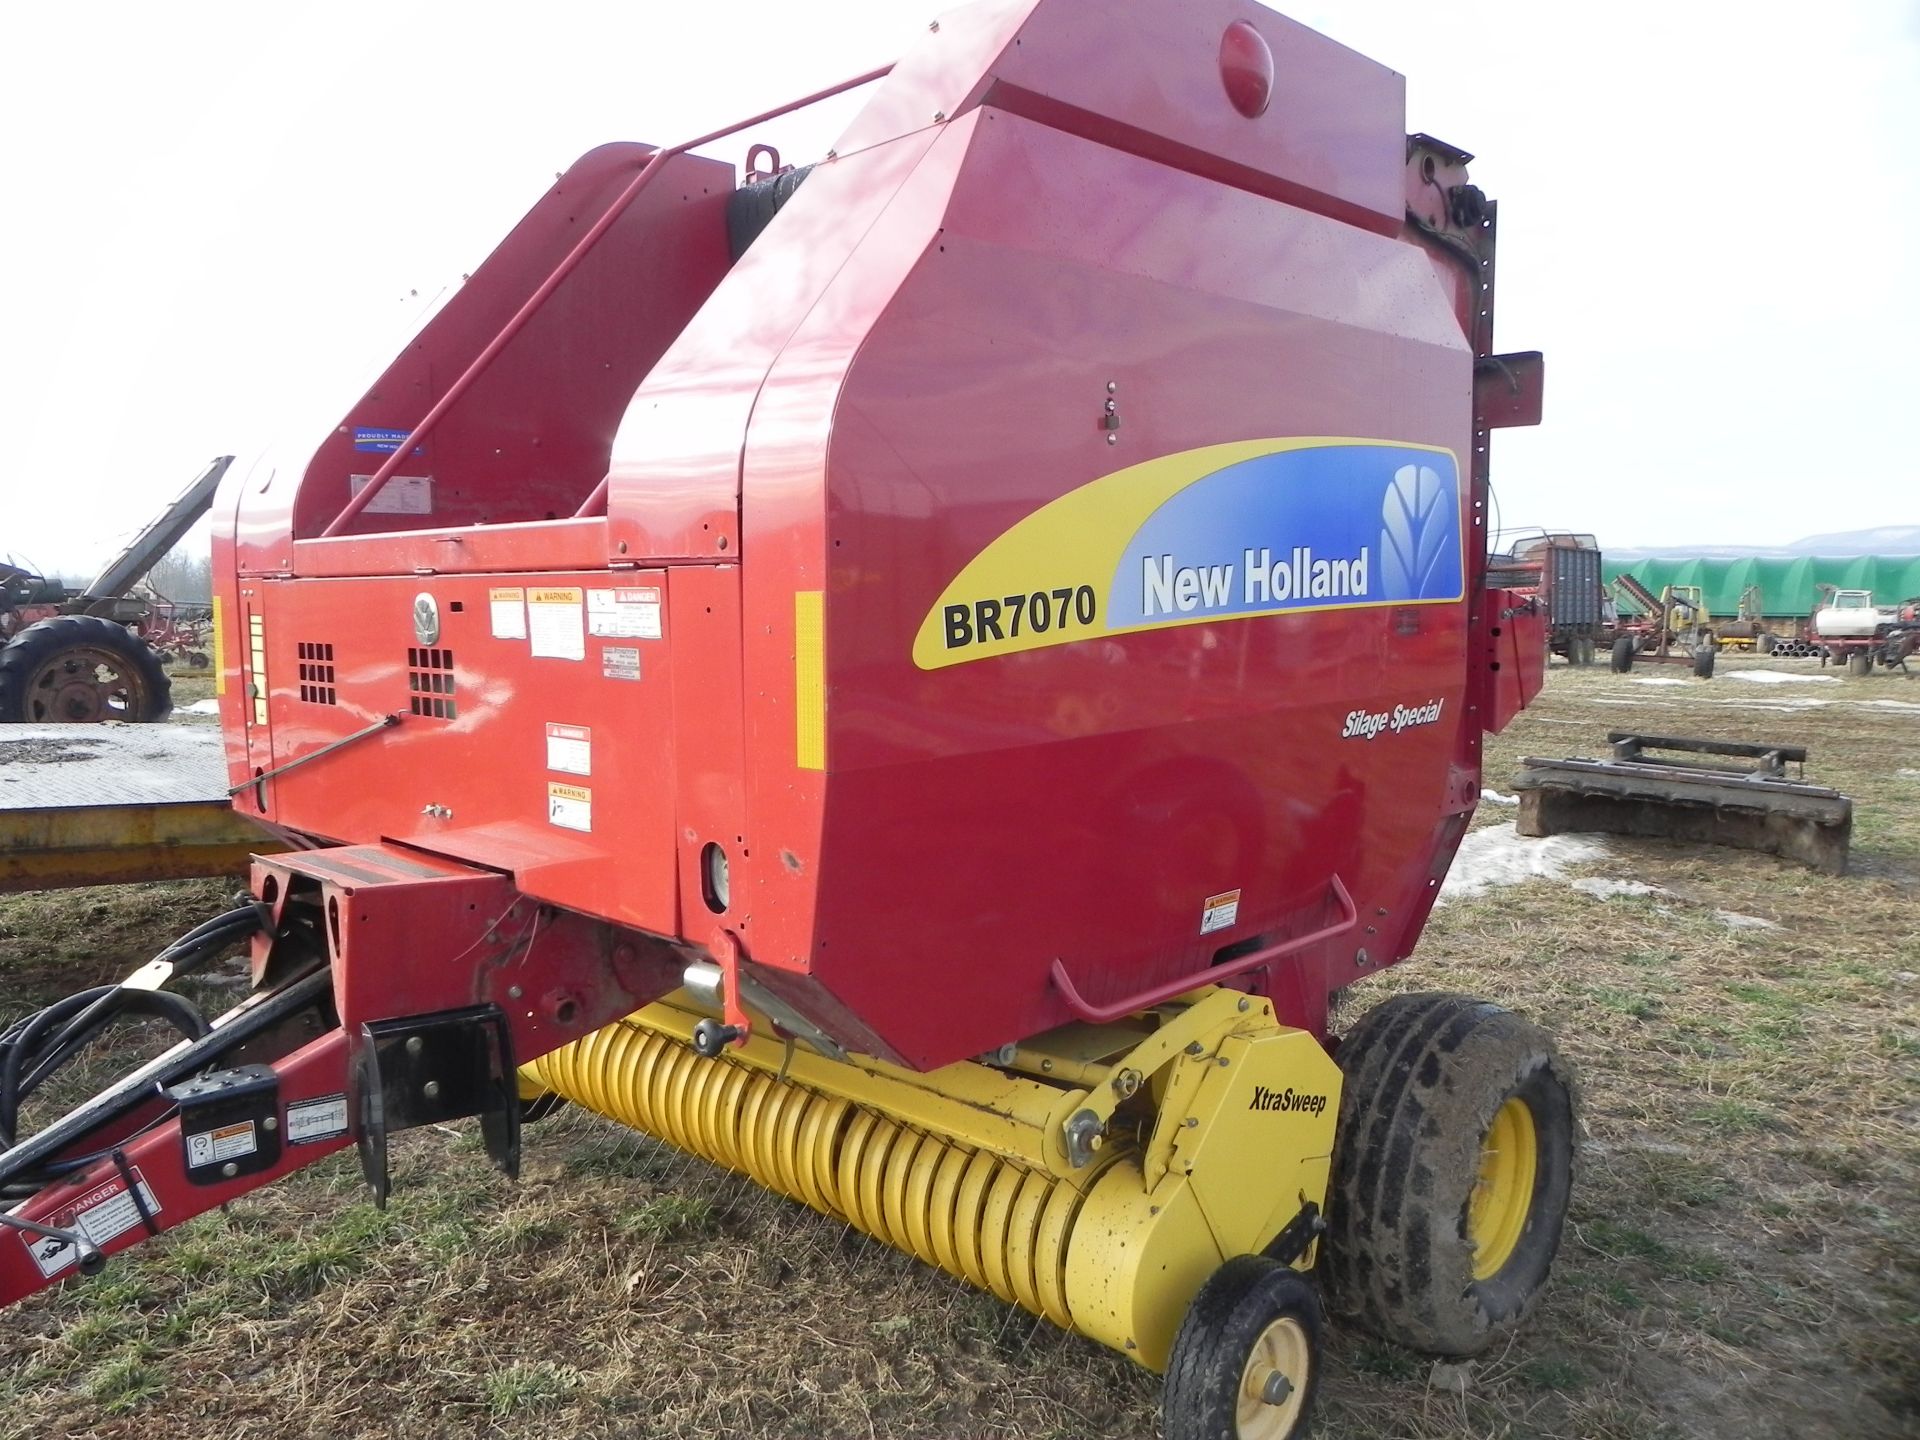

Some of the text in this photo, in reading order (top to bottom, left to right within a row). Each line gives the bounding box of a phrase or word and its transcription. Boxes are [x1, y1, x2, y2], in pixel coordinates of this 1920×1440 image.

[544, 592, 572, 601] WARNING
[1141, 546, 1368, 616] New Holland
[943, 584, 1096, 649] BR7070
[1342, 697, 1444, 740] Silage Special
[559, 789, 586, 800] WARNING
[1249, 1086, 1327, 1118] XtraSweep
[67, 1184, 119, 1214] DANGER
